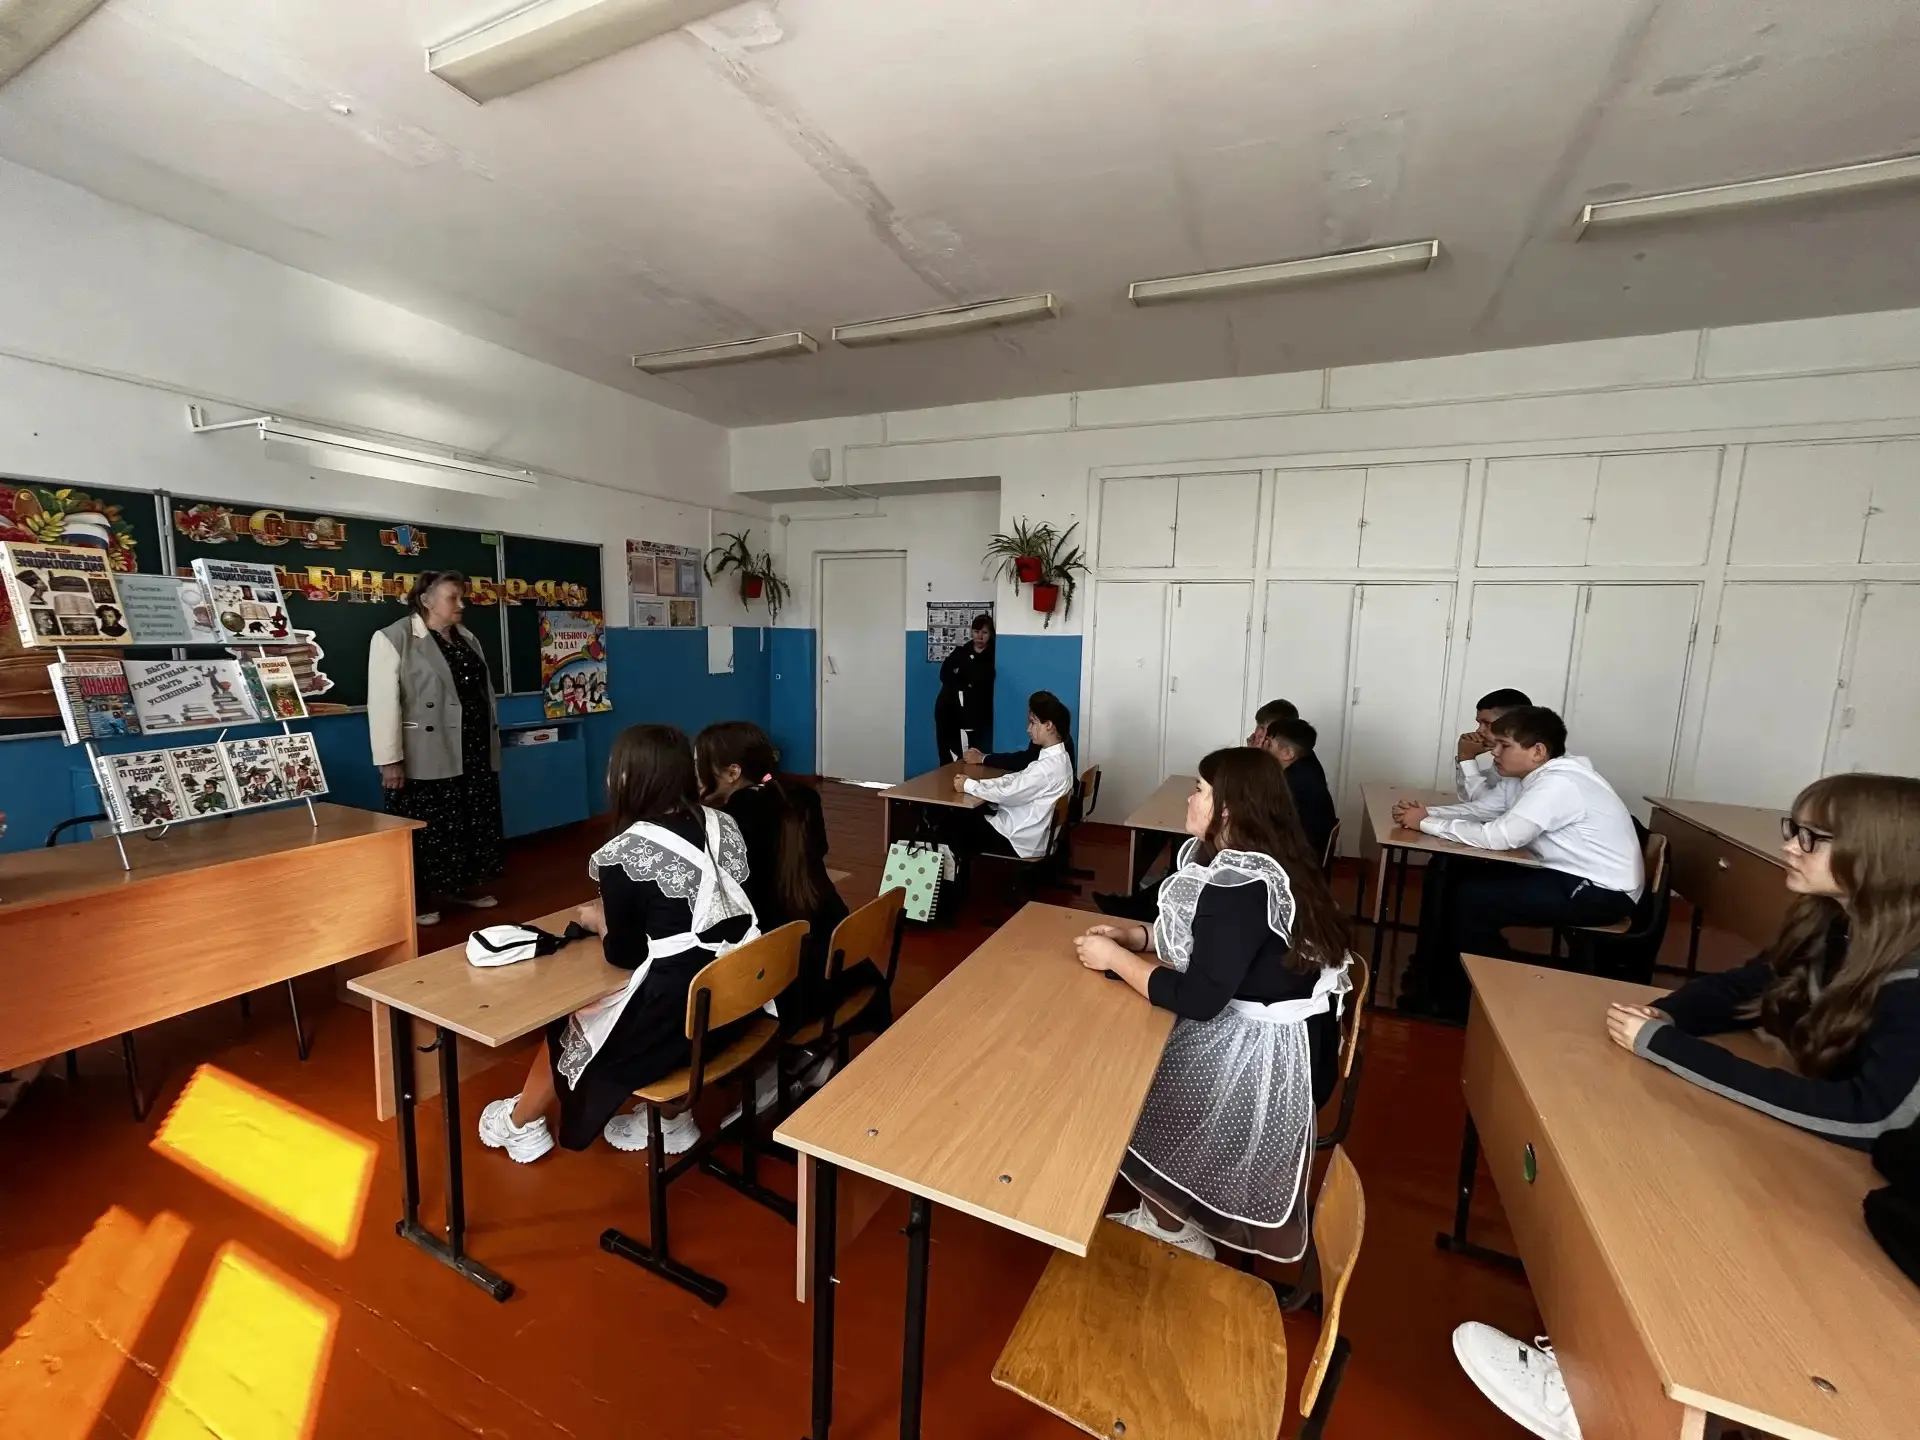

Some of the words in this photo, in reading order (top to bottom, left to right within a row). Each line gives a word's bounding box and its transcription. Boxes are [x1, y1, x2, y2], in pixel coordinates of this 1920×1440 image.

[250, 510, 289, 546] С
[16, 557, 107, 573] ЭНЦИКЛОПЕДИЯ
[208, 565, 238, 573] БОЛЬШАЯ
[239, 567, 272, 576] ШКОЛЬНАЯ
[210, 571, 274, 584] ЭНЦИКЛОПЕДИЯ
[554, 632, 587, 640] УЧЕБНОГО
[554, 641, 577, 650] ГОДА!
[145, 662, 171, 675] БЫТЬ
[131, 665, 188, 690] ГРАМОТНЫМ
[157, 679, 183, 691] БЫТЬ
[147, 680, 204, 706] УСПЕШНЫМ!
[238, 748, 267, 757] ПОЗНАЮ
[283, 745, 309, 753] ПОЗНАЮ
[176, 760, 183, 768] Я
[184, 757, 217, 767] ПОЗНАЮ
[119, 769, 127, 778] Я
[128, 765, 165, 776] ПОЗНАЮ
[190, 764, 206, 773] МИР
[134, 774, 153, 782] МИР
